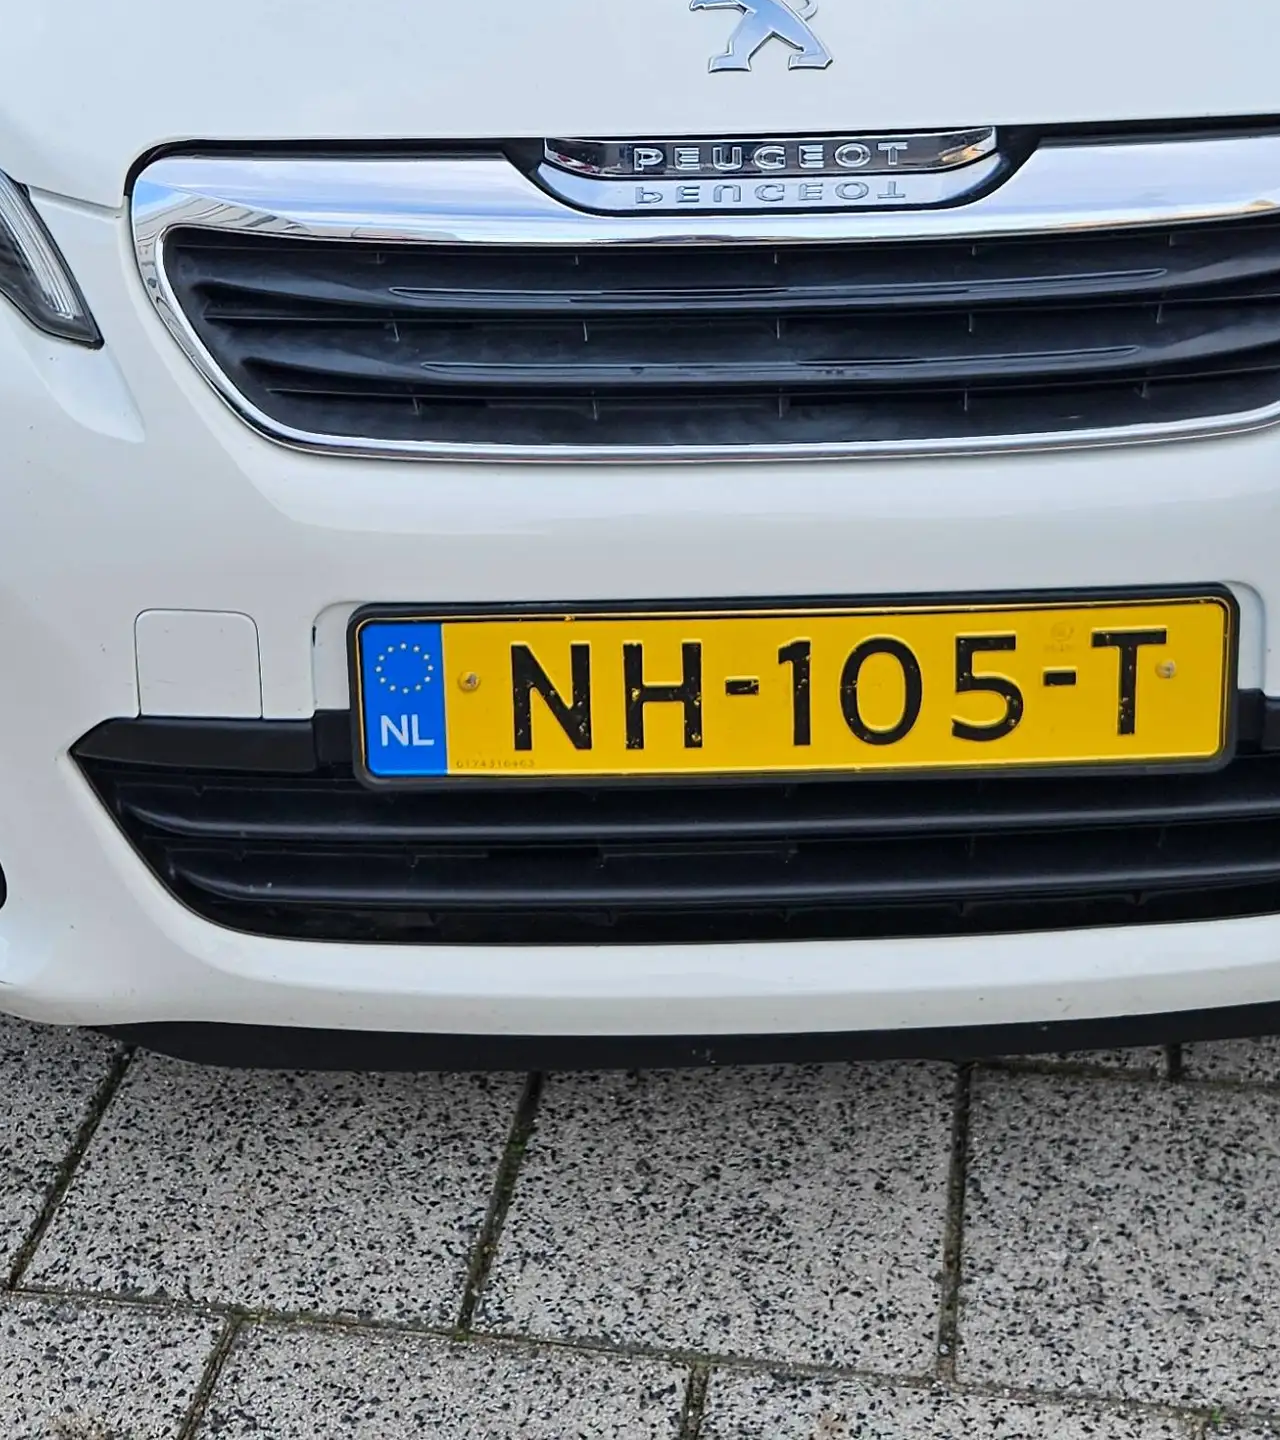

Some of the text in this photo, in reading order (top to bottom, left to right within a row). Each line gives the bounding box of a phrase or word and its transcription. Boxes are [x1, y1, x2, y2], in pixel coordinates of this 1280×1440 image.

[632, 141, 909, 172] PEUGEOT
[509, 626, 1170, 752] NH-105-T
[379, 713, 436, 747] NL
